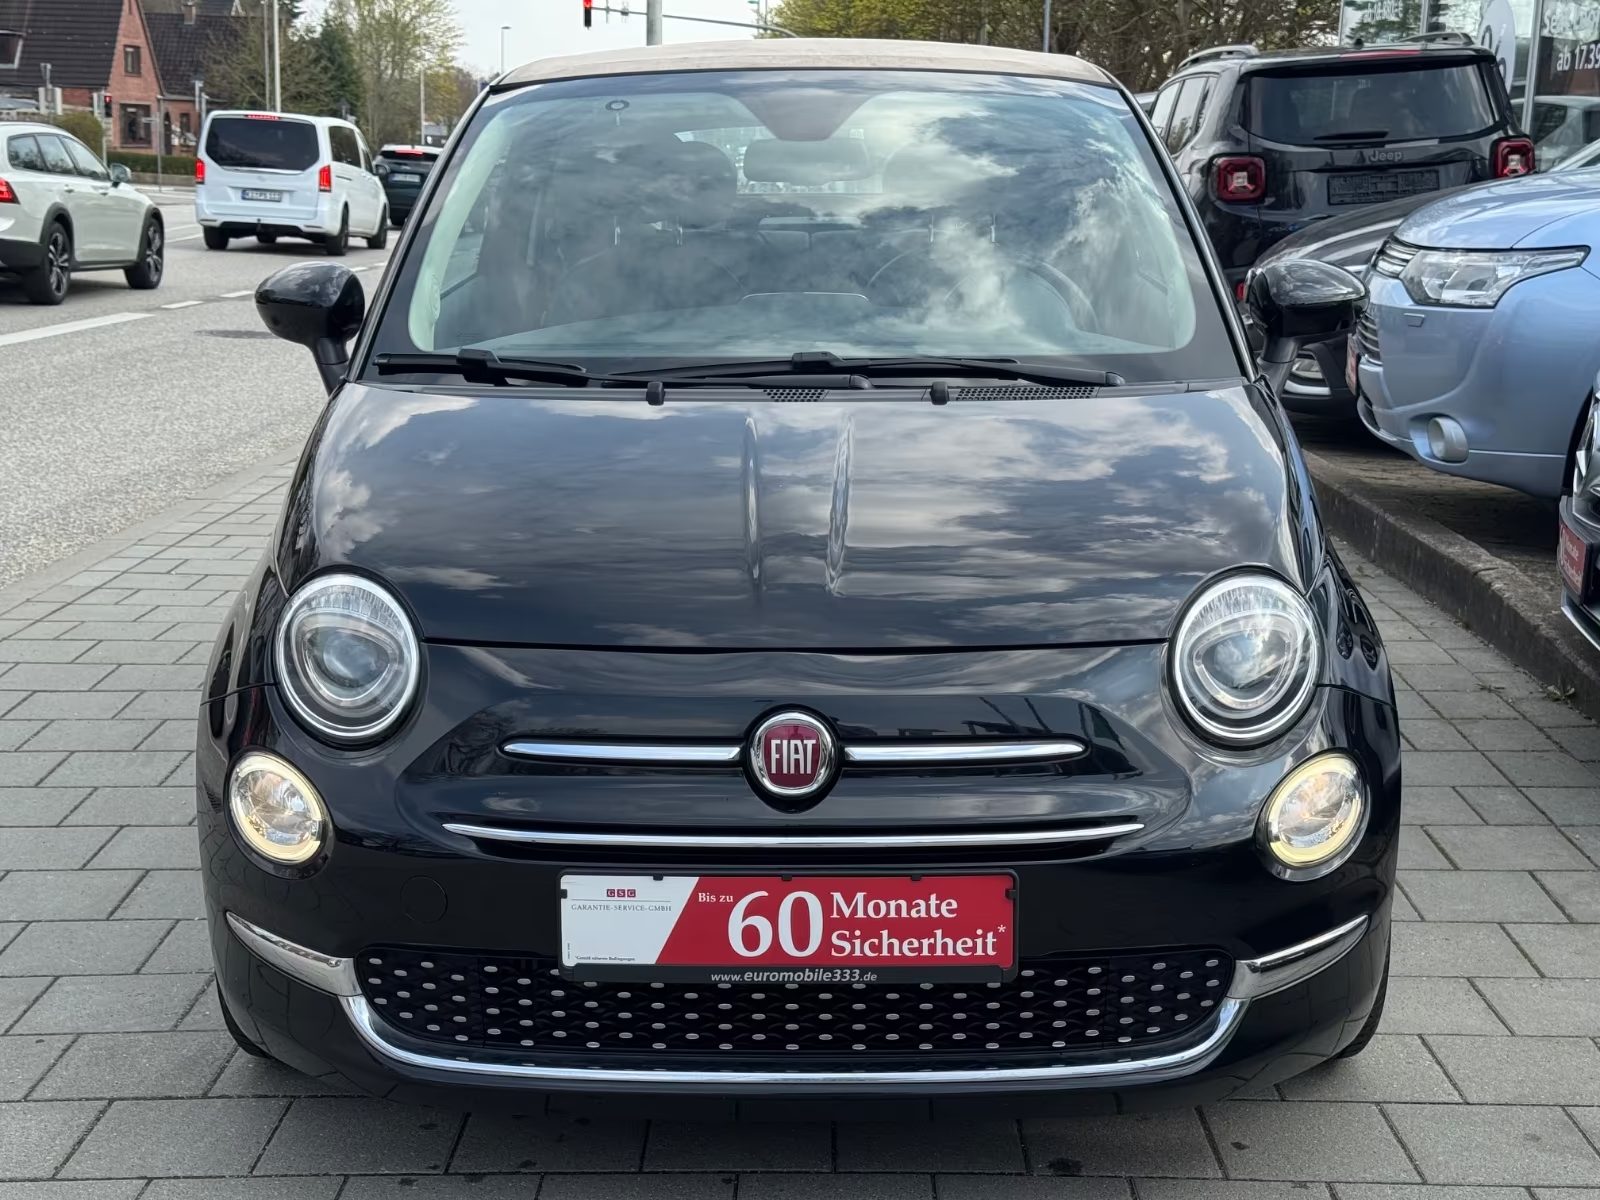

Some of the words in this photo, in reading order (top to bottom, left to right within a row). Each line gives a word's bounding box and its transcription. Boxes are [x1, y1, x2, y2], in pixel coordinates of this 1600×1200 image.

[1556, 45, 1571, 71] ab
[1370, 149, 1402, 162] Jeep
[770, 739, 817, 775] FIAT
[606, 888, 636, 898] GSG
[698, 892, 716, 903] Bis
[719, 894, 734, 903] zu
[571, 903, 672, 912] GARANTIE-SERVICE-GMBH
[830, 892, 958, 919] Monate
[728, 890, 823, 957] 60
[710, 968, 878, 983] www.euromobile333.de
